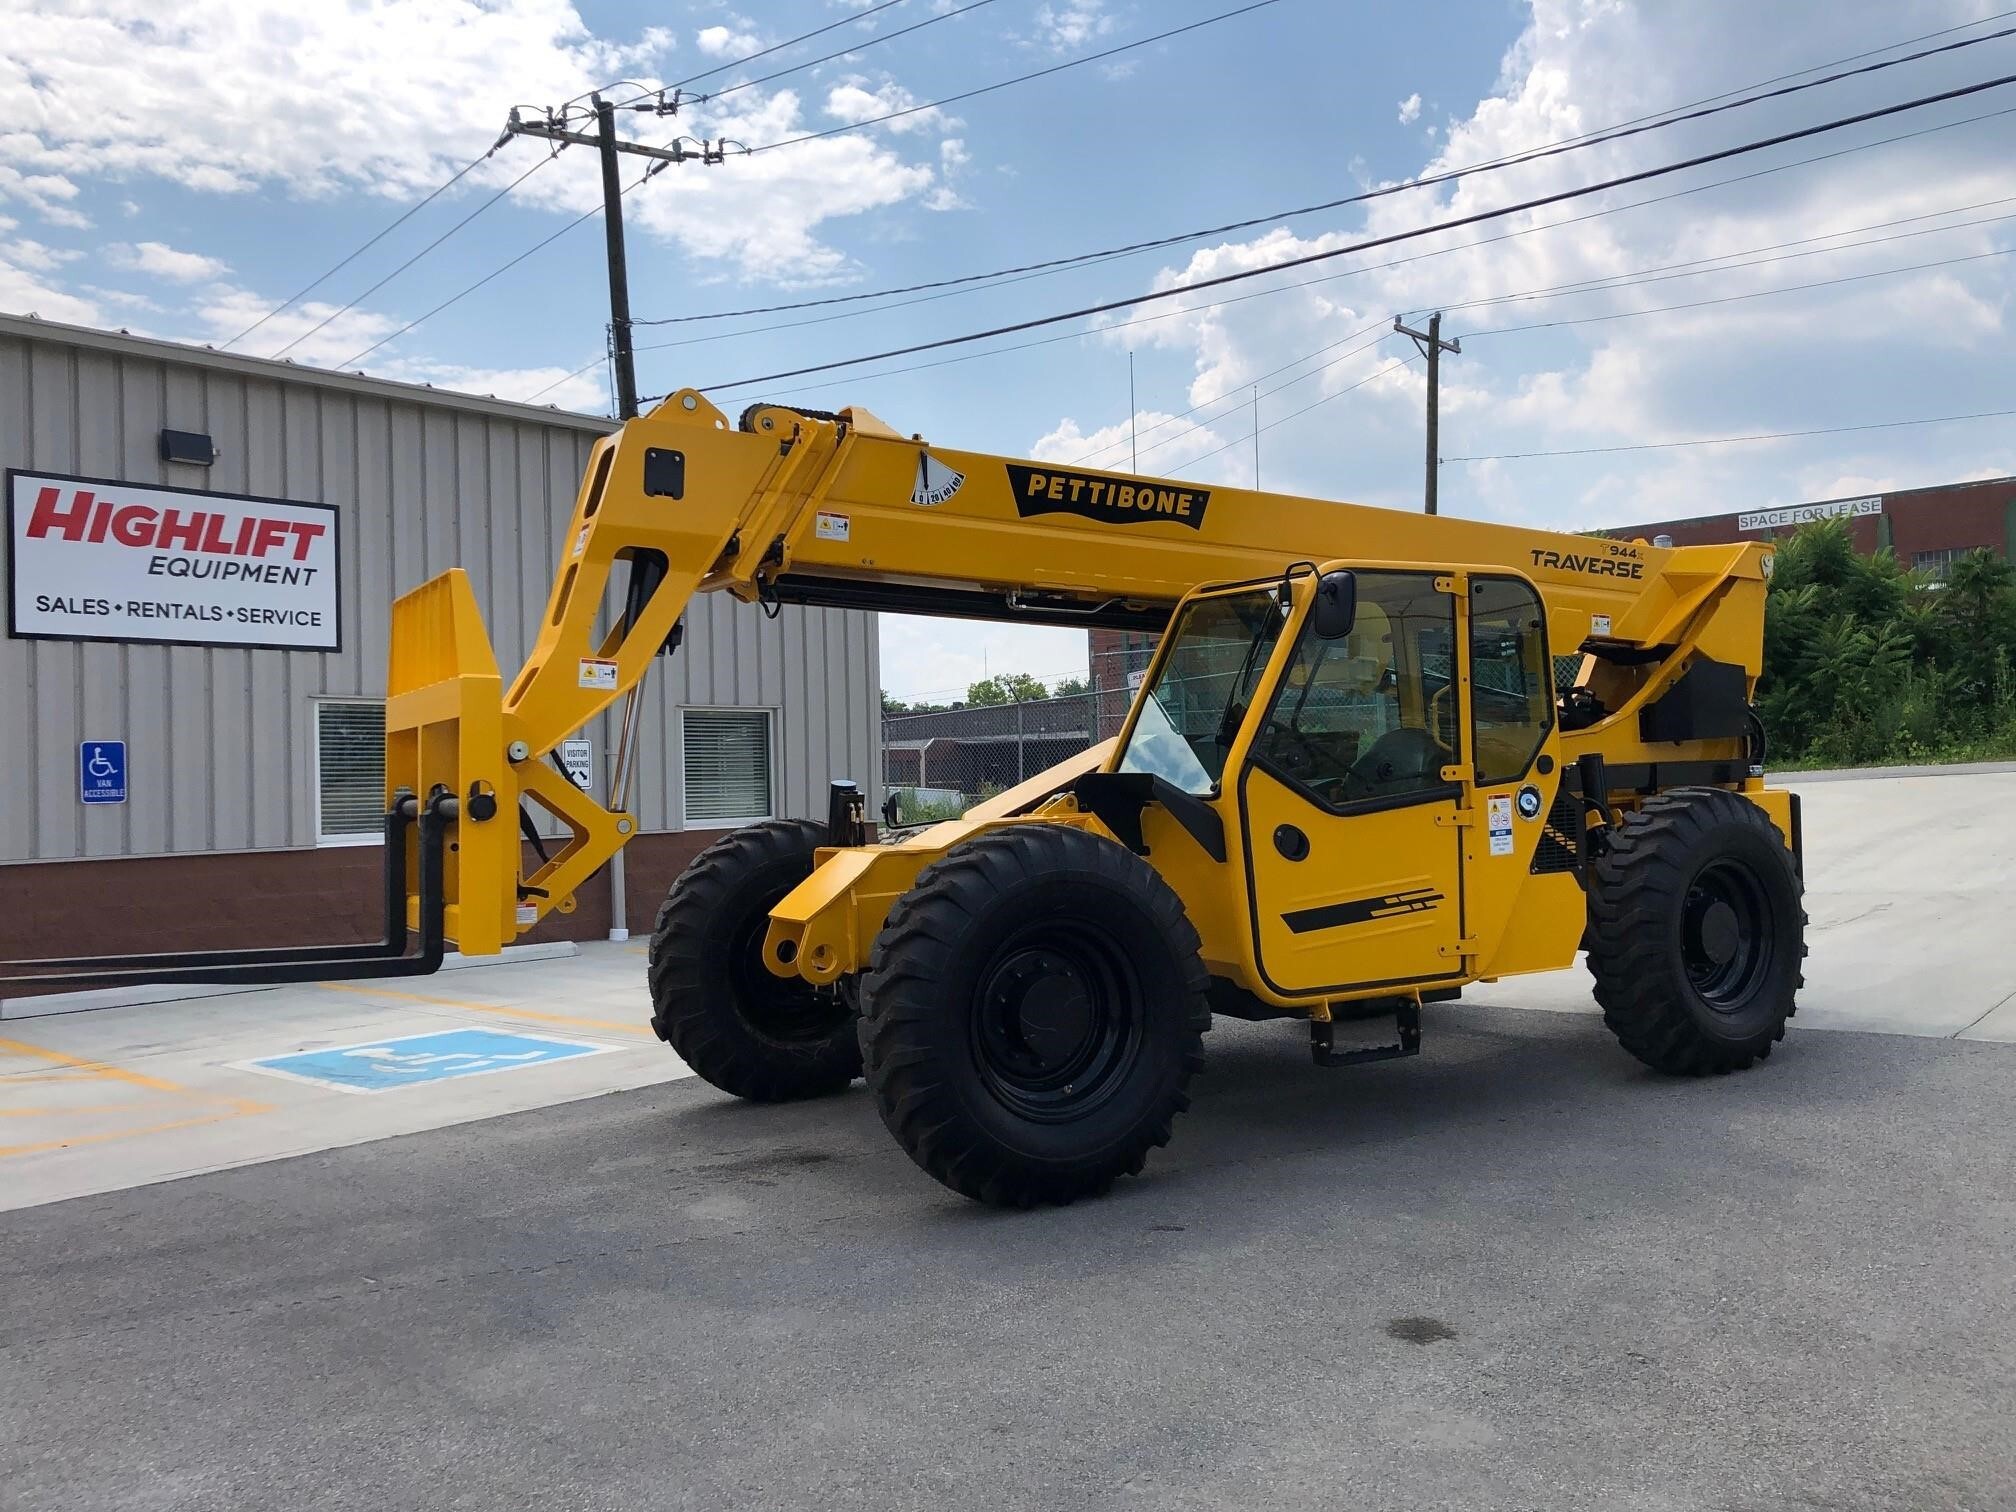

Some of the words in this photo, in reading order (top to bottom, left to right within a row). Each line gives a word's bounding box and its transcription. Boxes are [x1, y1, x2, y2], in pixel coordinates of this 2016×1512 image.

[930, 493, 940, 502] 20
[943, 487, 952, 497] 40
[952, 477, 961, 488] 60
[1027, 473, 1192, 516] PETTIBONE
[26, 486, 326, 561] HIGHLIFT
[1740, 511, 1788, 528] SPACE
[1792, 507, 1825, 523] FOR
[1829, 499, 1881, 516] LEASE
[147, 555, 318, 586] EQUIPMENT
[1531, 549, 1645, 580] TRAVERSE
[35, 595, 110, 616] SALES
[127, 600, 223, 622] RENTALS
[236, 608, 322, 627] SERVICE
[566, 760, 589, 768] PARKING
[84, 789, 125, 797] ACCESSIBLE
